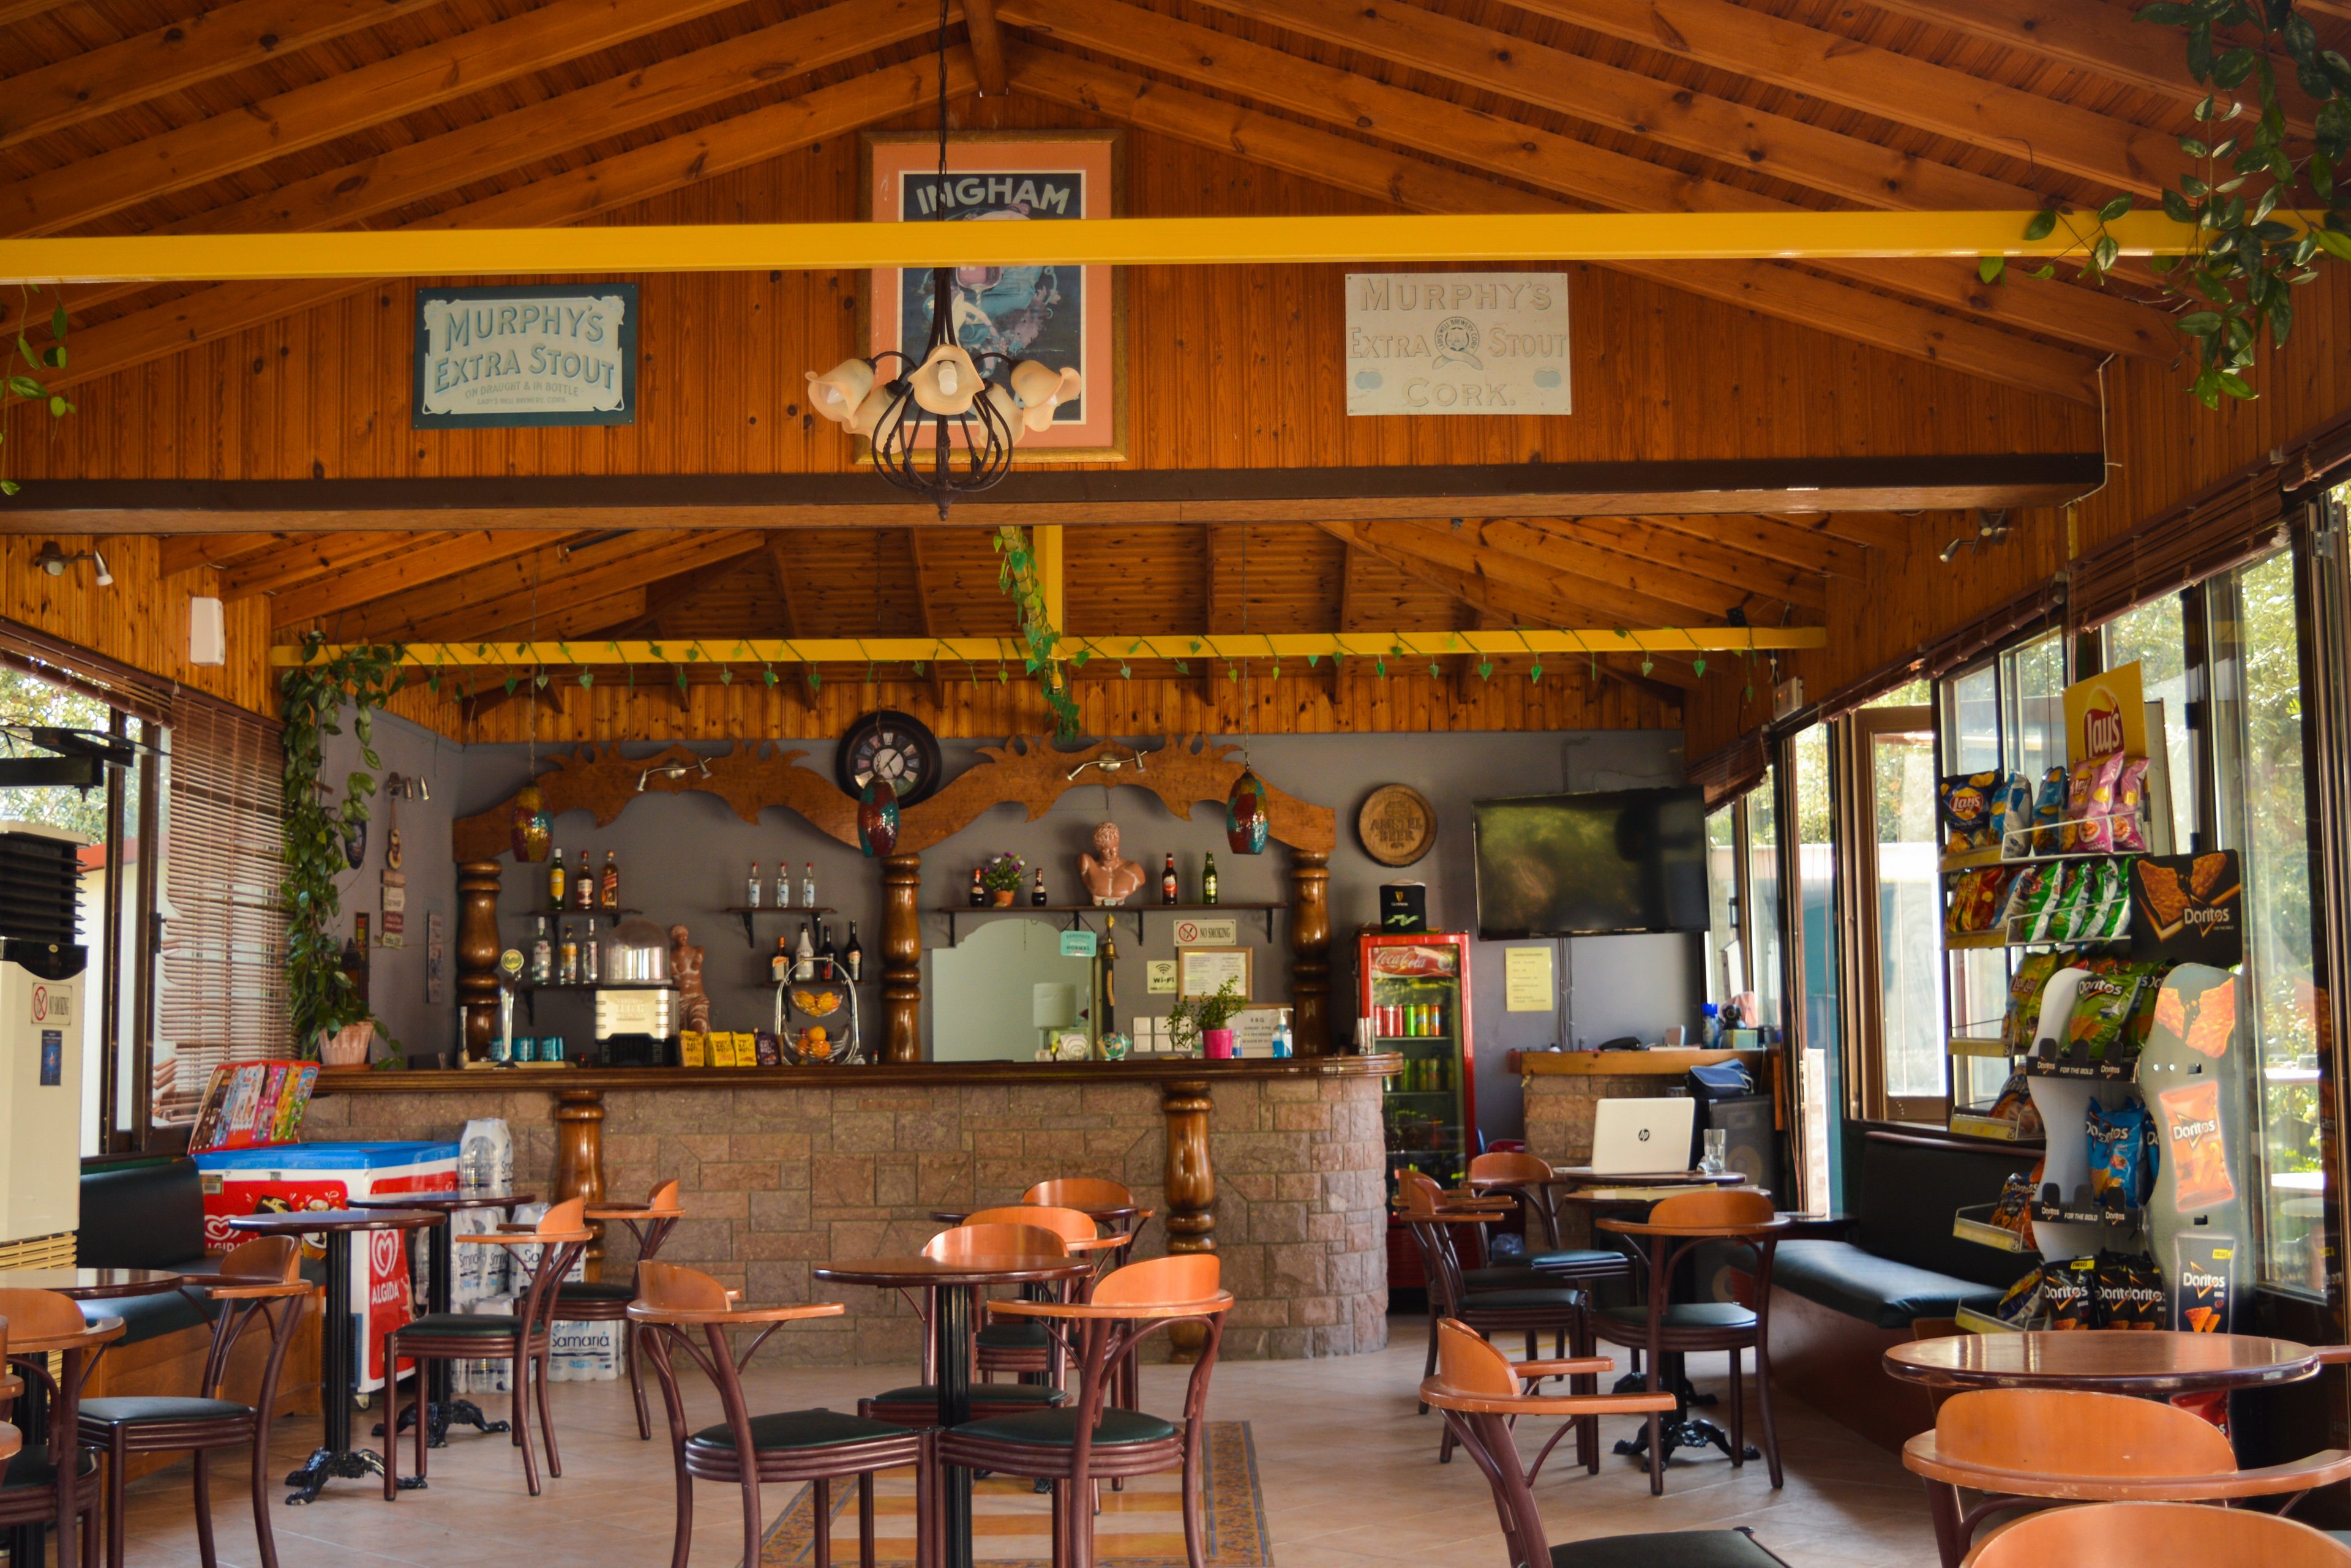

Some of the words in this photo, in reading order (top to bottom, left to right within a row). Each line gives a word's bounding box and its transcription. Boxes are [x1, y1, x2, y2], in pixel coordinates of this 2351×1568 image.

[916, 177, 1070, 215] INGHAM
[1360, 277, 1552, 312] MURPHY'S
[444, 304, 604, 353] MURPHY'S
[1438, 322, 1450, 333] WELL
[1450, 319, 1475, 331] BREWERY
[1348, 327, 1432, 359] EXTRA
[1487, 326, 1567, 358] STOUT
[434, 350, 522, 394] EXTRA
[528, 342, 615, 390] STOUT
[465, 388, 479, 399] ON
[481, 381, 520, 397] DRAUGHT
[523, 381, 531, 391] &
[533, 380, 543, 391] IN
[546, 382, 579, 397] BOTTLE
[478, 397, 499, 405] LADY'S
[1370, 817, 1423, 831] AMSTEL
[2184, 907, 2230, 925] Doritos
[1200, 927, 1207, 938] NO
[1208, 927, 1231, 938] SMOKING
[2078, 979, 2124, 996] Doritos
[2037, 1061, 2055, 1070] Doritos
[2101, 1065, 2120, 1074] Doritos
[1639, 1129, 1649, 1141] hp
[2173, 1119, 2216, 1140] Doritos
[2041, 1206, 2060, 1216] Doritos
[2105, 1211, 2125, 1220] Doritos
[2182, 1272, 2226, 1288] Doritos
[372, 1282, 399, 1305] ALGIDA
[2044, 1285, 2088, 1300] Doritos
